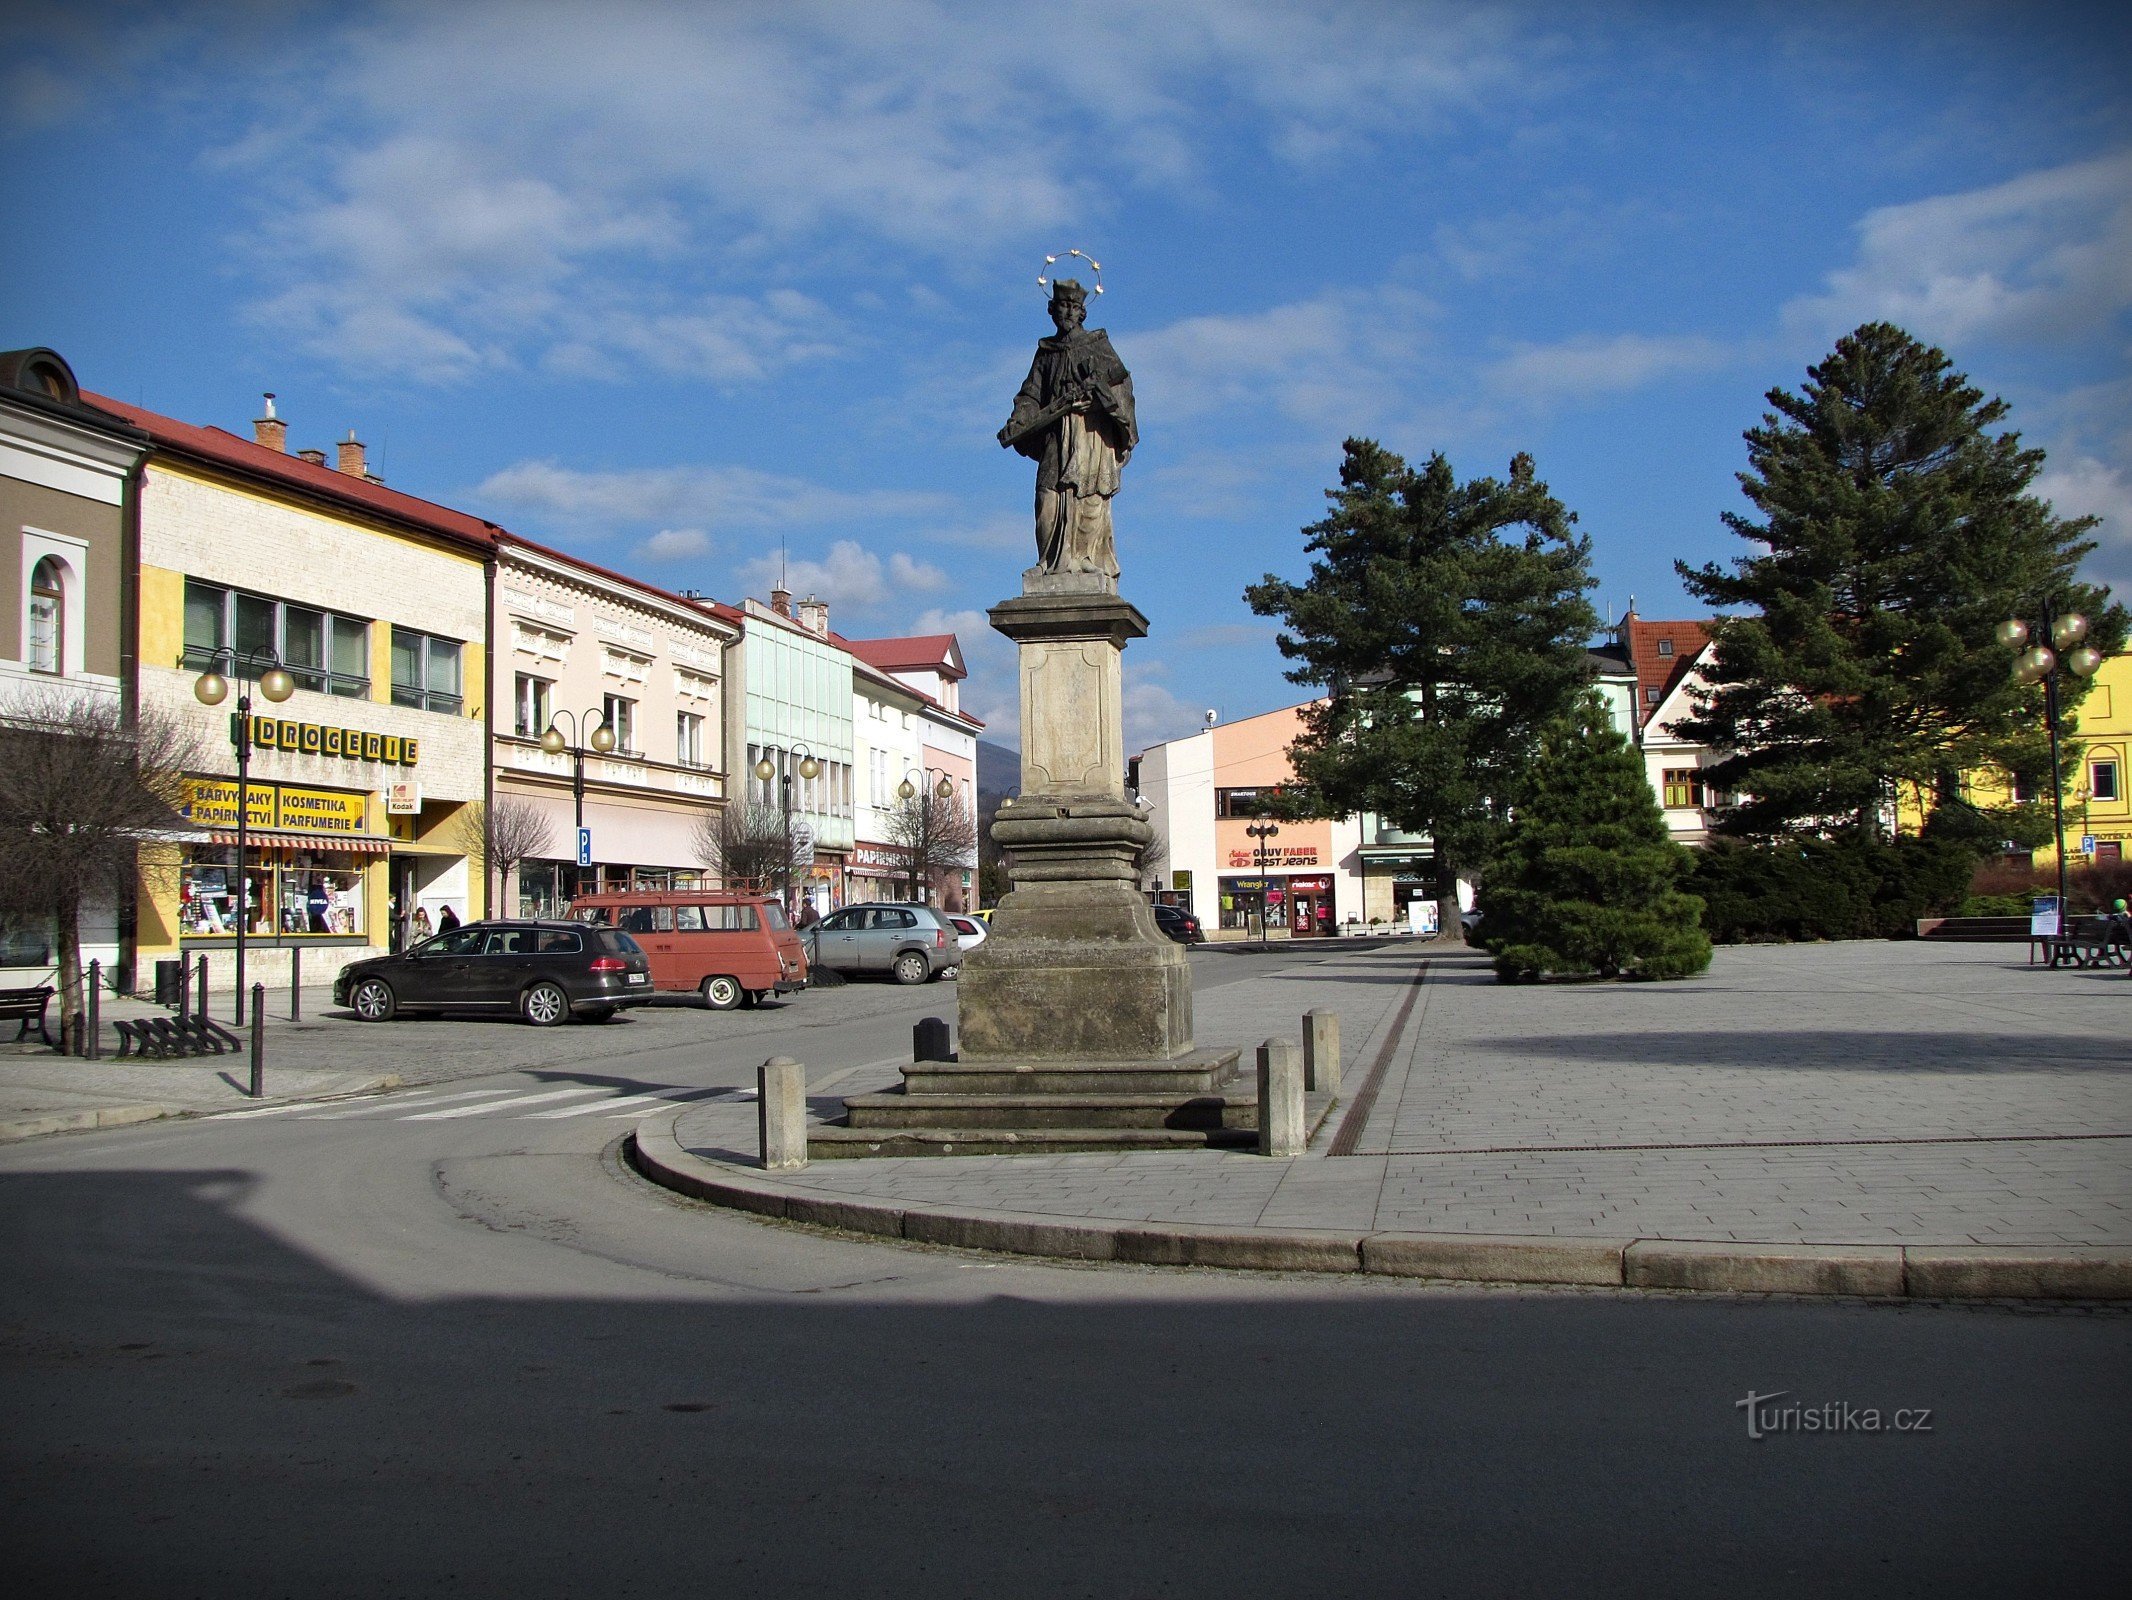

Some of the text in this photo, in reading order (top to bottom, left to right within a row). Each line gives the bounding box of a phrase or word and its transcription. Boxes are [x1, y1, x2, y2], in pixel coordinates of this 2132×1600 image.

[262, 722, 416, 759] DROGERIE
[282, 795, 346, 812] KOSMETIKA
[196, 806, 271, 825] PAPÍRNCTVÍ
[283, 813, 351, 830] PARFUMERIE
[581, 832, 588, 853] P
[1283, 847, 1318, 856] FABER
